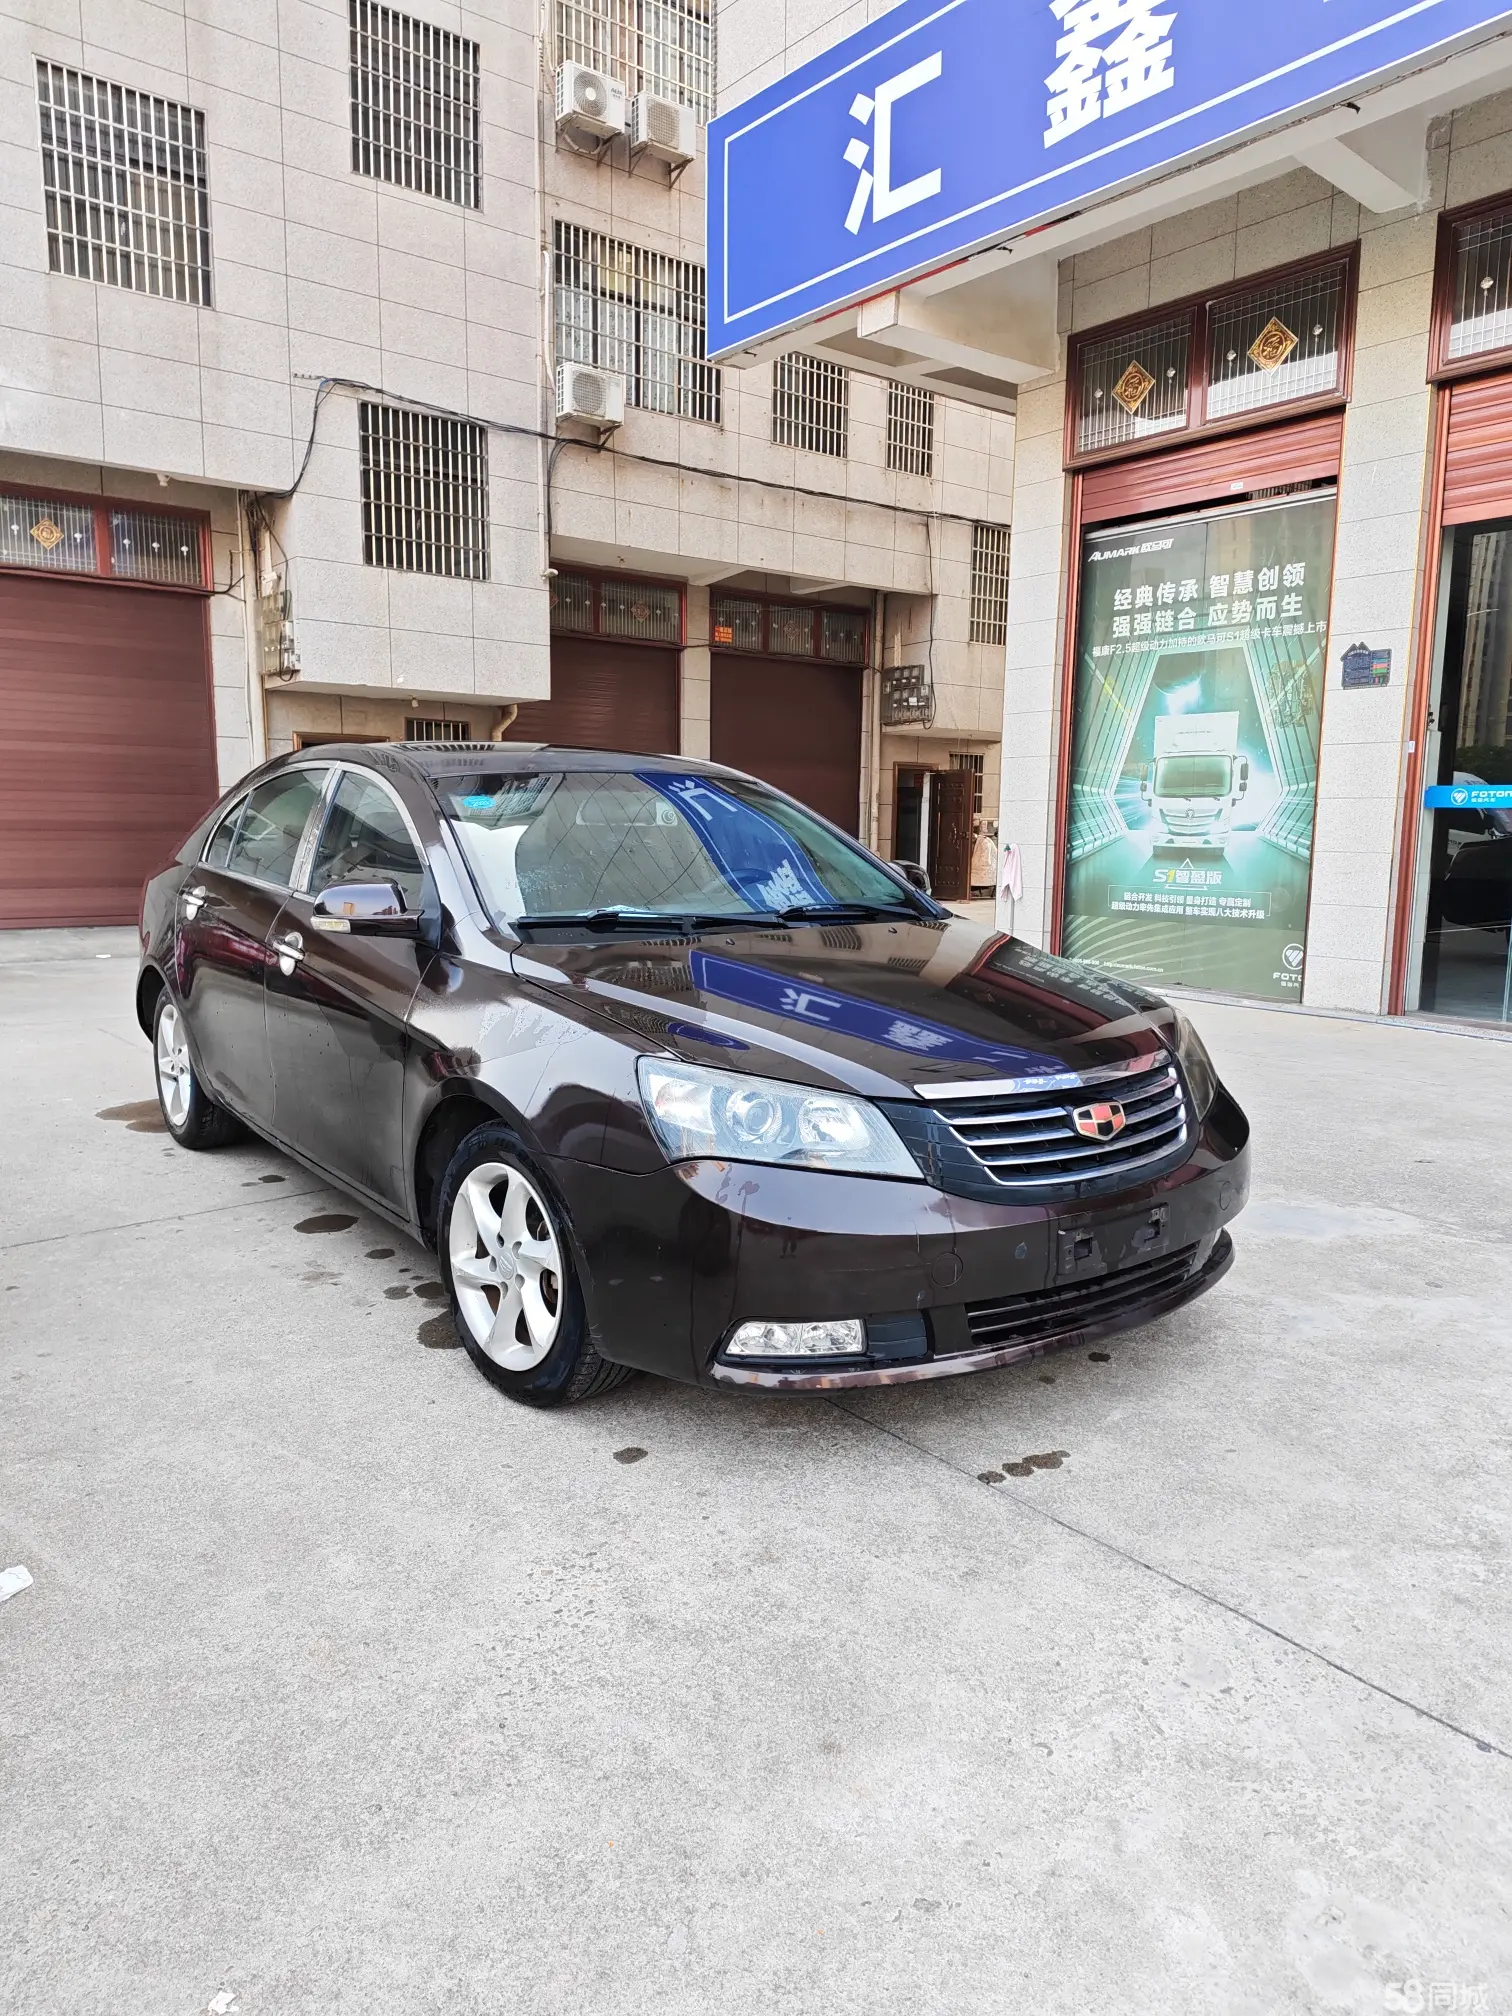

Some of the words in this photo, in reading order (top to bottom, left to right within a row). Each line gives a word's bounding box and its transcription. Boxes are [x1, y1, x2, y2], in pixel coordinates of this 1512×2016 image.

[1113, 578, 1199, 611] 经典传承
[1209, 562, 1306, 599] 智慧创领
[1112, 606, 1197, 638] 强强链合
[1208, 592, 1303, 627] 应势而生
